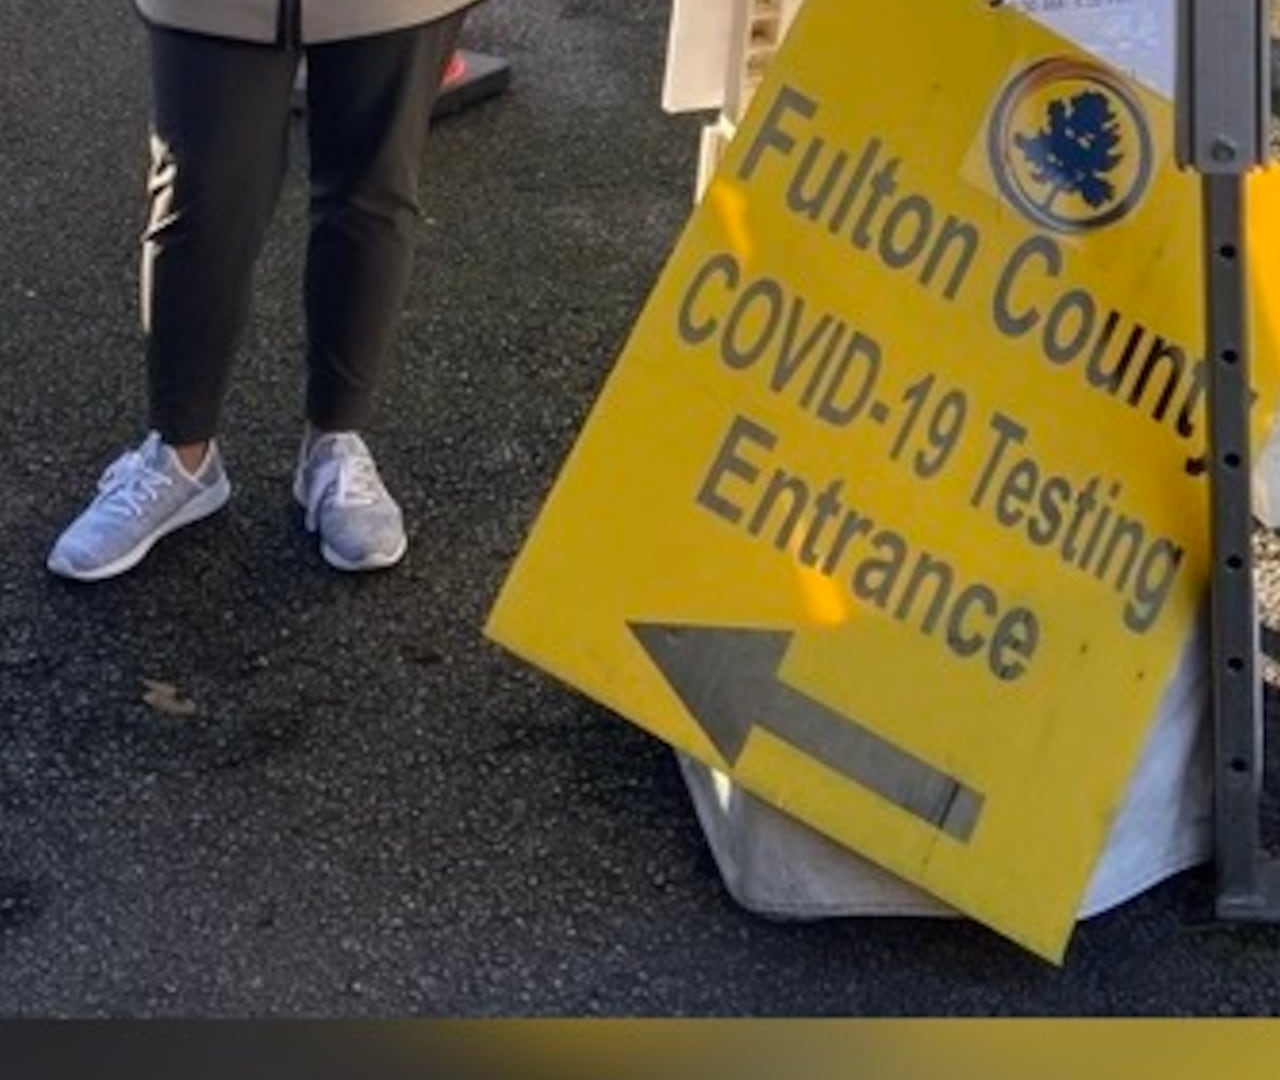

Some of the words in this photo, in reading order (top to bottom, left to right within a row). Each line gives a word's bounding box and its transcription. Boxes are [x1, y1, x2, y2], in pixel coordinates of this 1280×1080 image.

[676, 253, 969, 480] COVID-19
[968, 412, 1185, 635] Testing
[736, 86, 980, 301] Fulton
[991, 234, 1258, 477] Count
[694, 413, 1041, 684] Entrance
